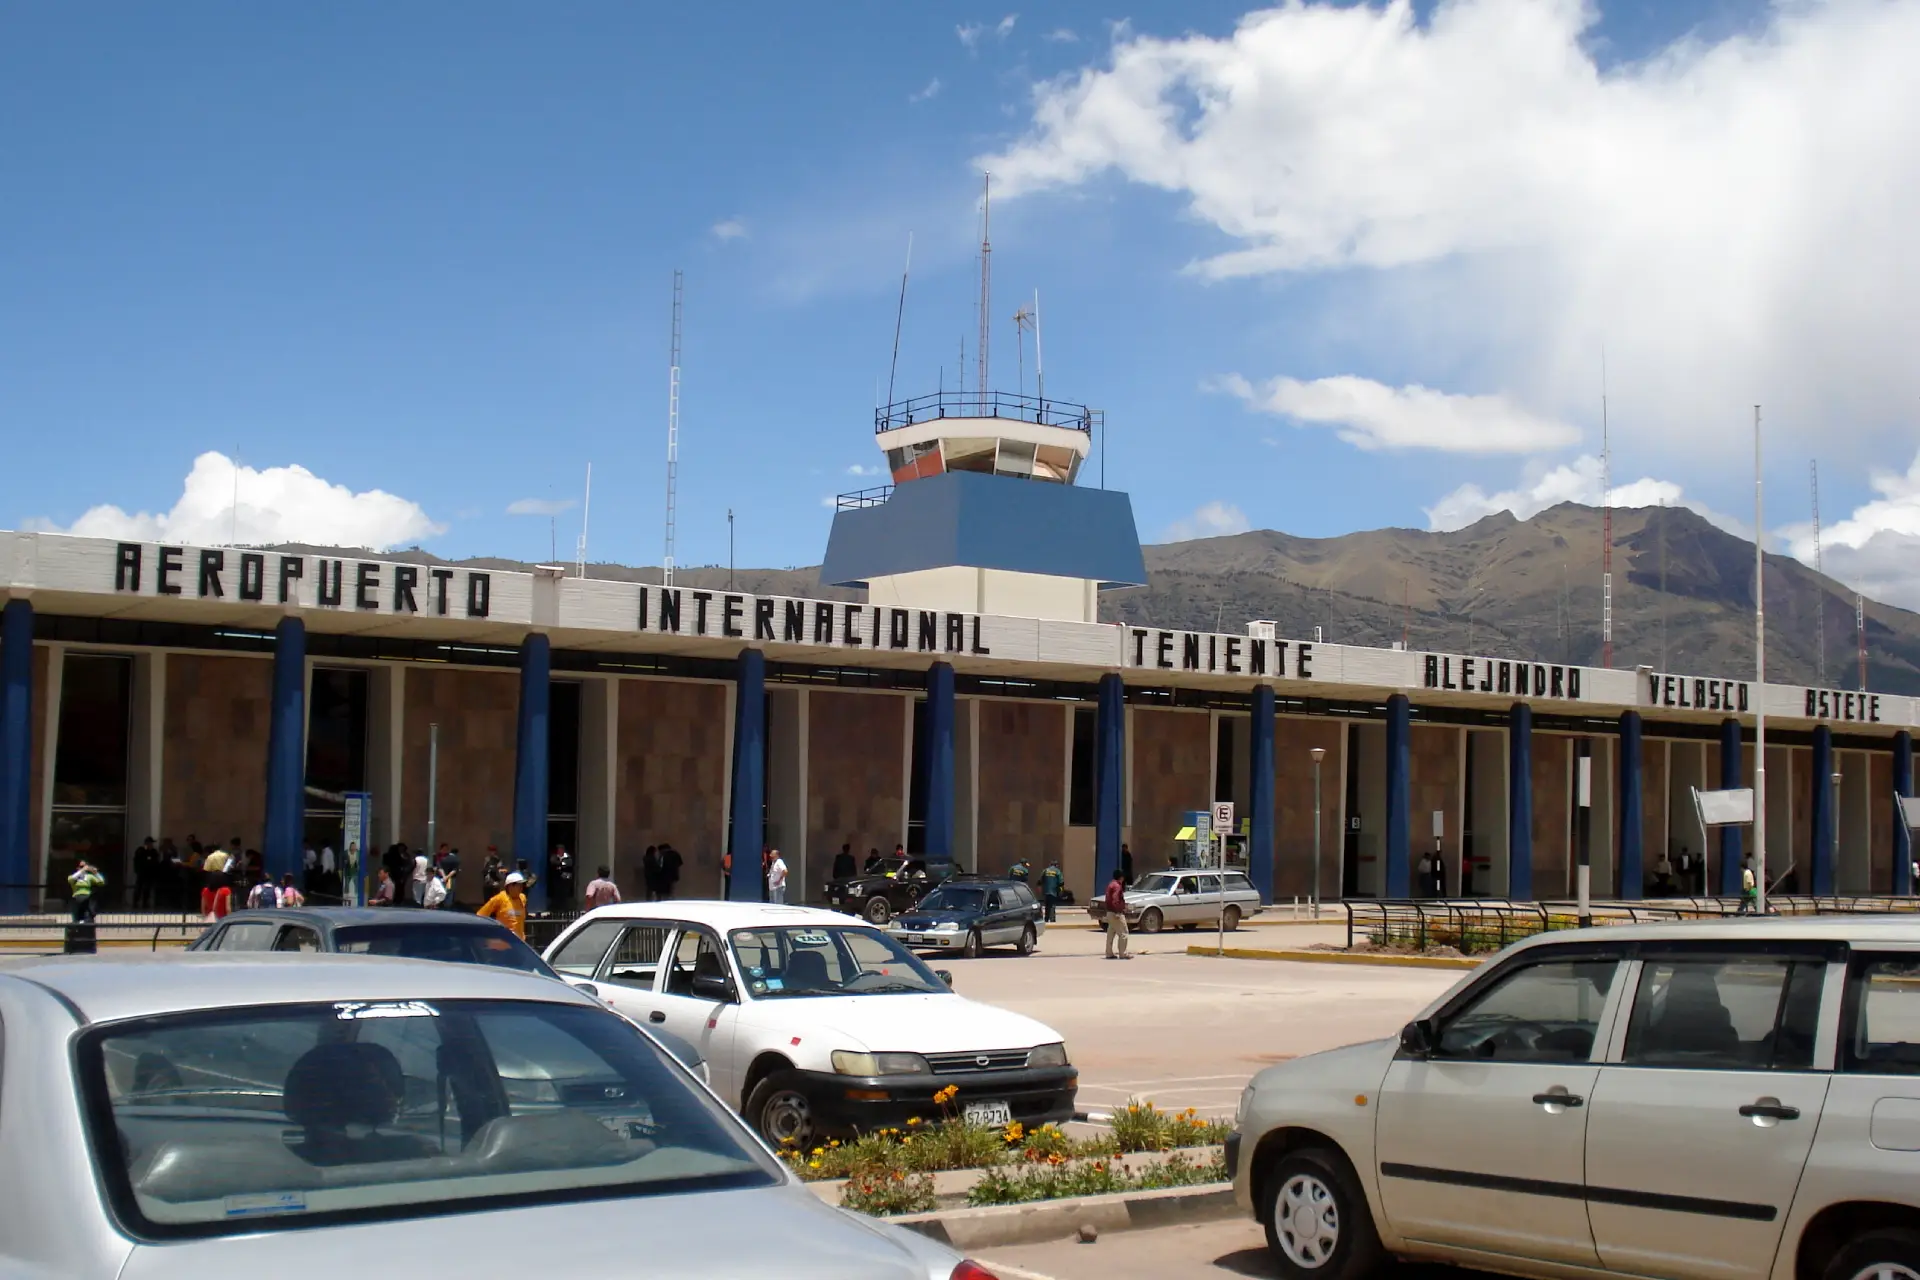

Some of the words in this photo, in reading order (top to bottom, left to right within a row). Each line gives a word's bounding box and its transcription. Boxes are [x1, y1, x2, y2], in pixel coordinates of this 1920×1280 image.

[115, 543, 490, 617] AEROPUERTO
[639, 587, 990, 655] INTERNACIONAL
[1132, 629, 1312, 678] TENIENTE
[1424, 655, 1580, 699] ALEJANDRO
[1650, 675, 1748, 712] VELASCO
[1805, 688, 1880, 722] ASTETE
